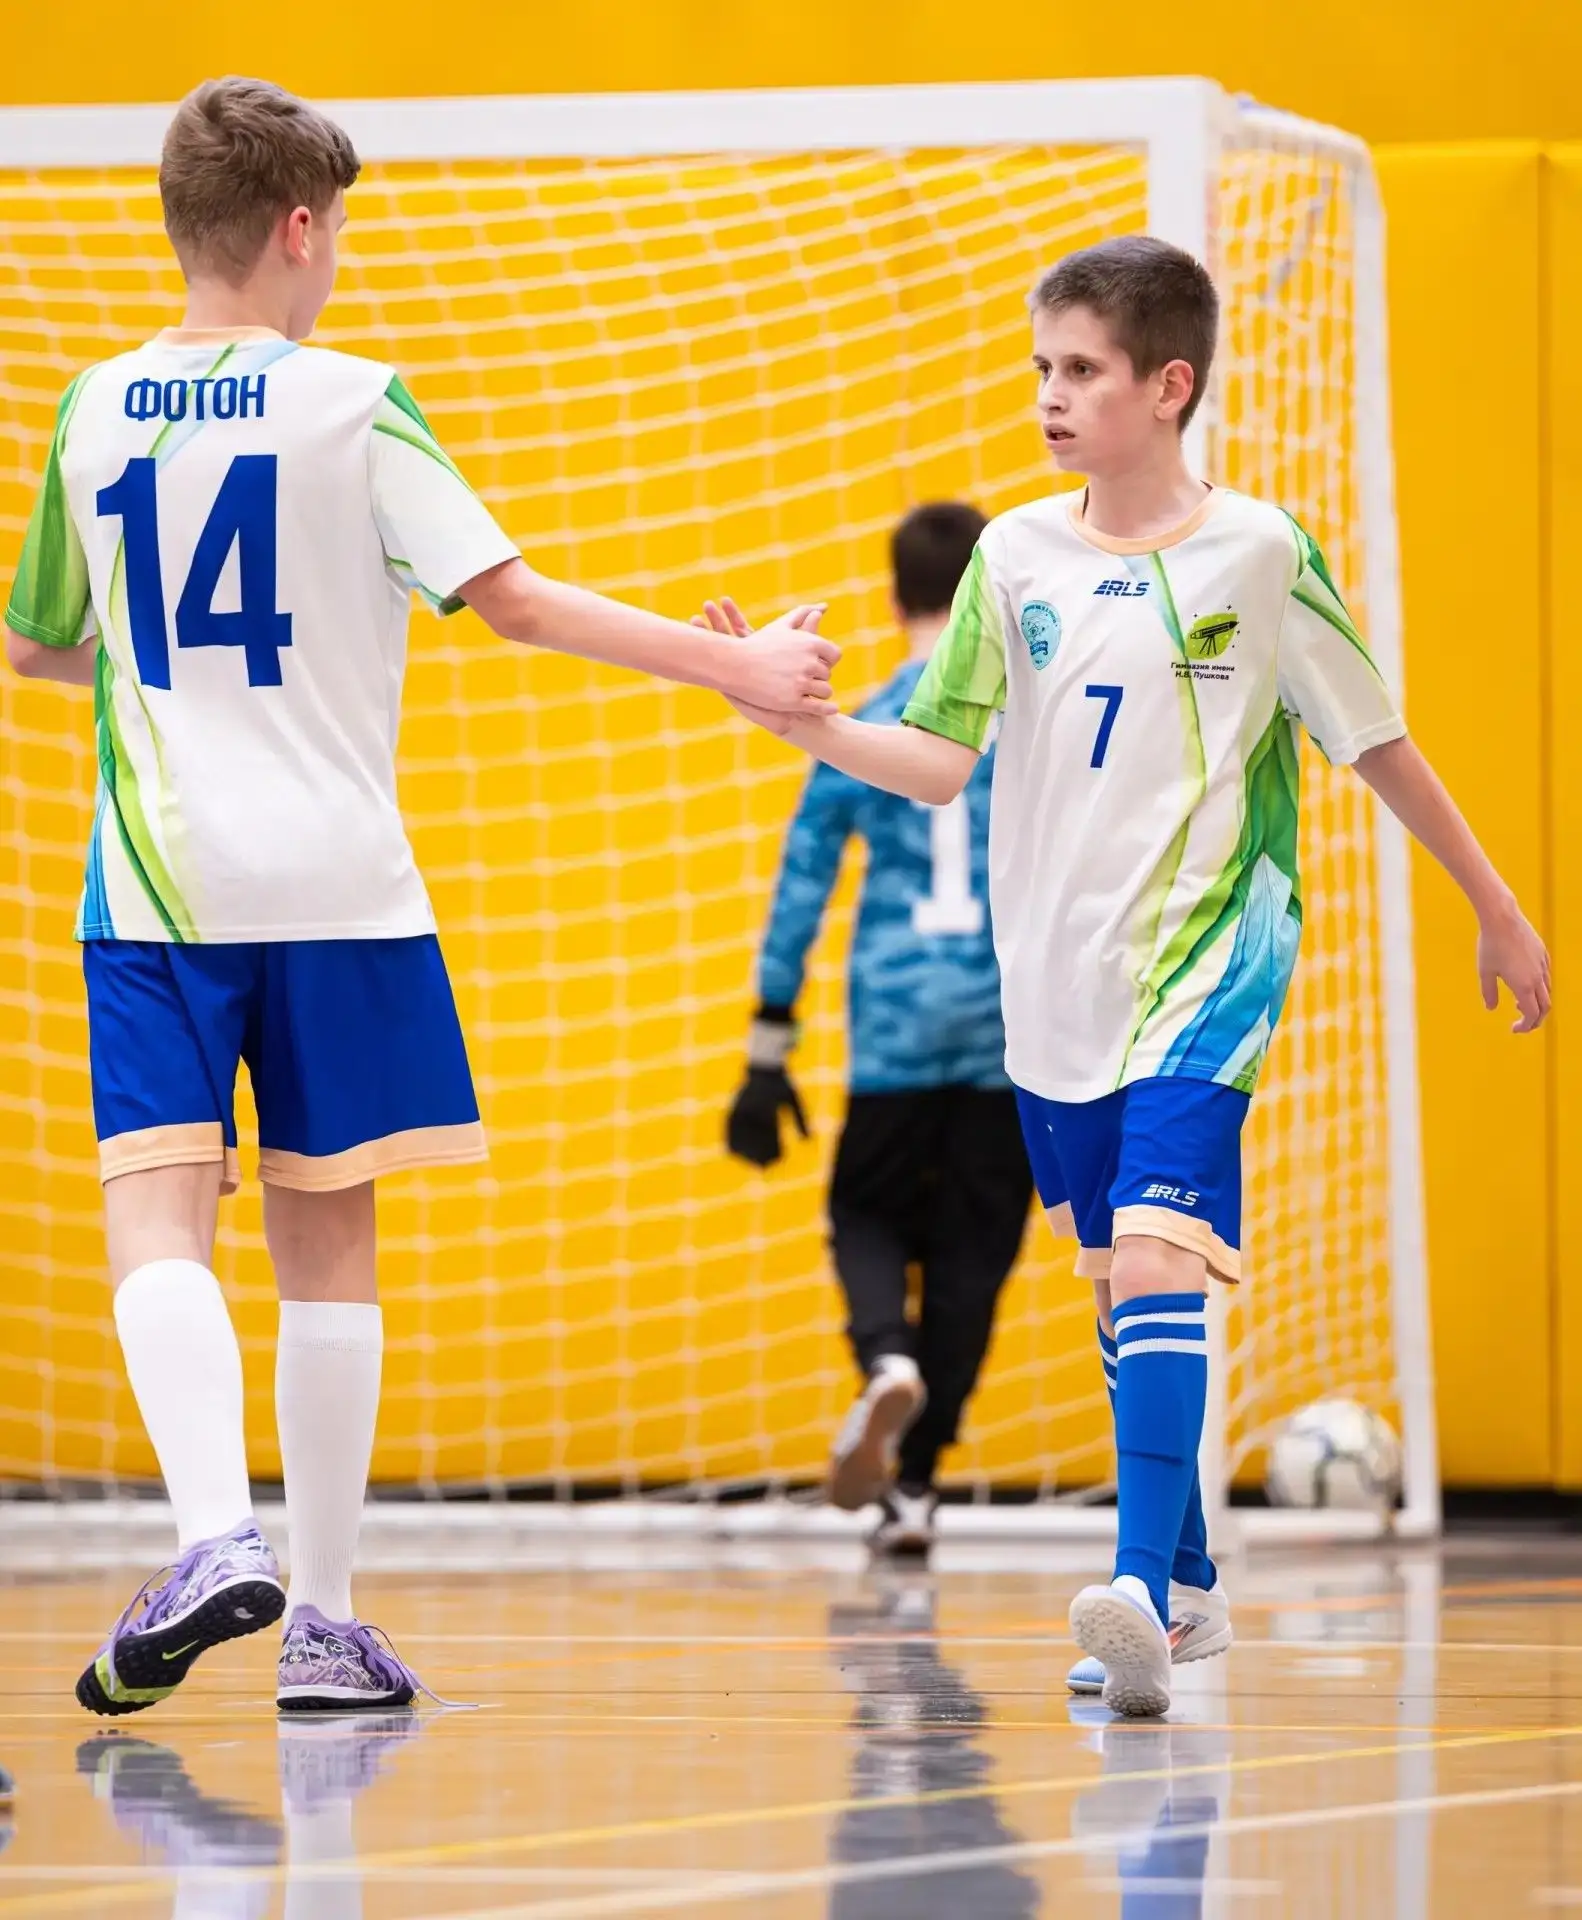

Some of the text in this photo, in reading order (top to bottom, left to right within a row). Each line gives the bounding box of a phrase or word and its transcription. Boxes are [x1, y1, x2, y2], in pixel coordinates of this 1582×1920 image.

[124, 374, 267, 422] ФОТОН
[96, 454, 293, 691] 14
[1171, 662, 1235, 672] Гимназия имени
[1193, 671, 1229, 680] Пушкова
[1085, 684, 1124, 768] 7
[913, 790, 984, 935] 1
